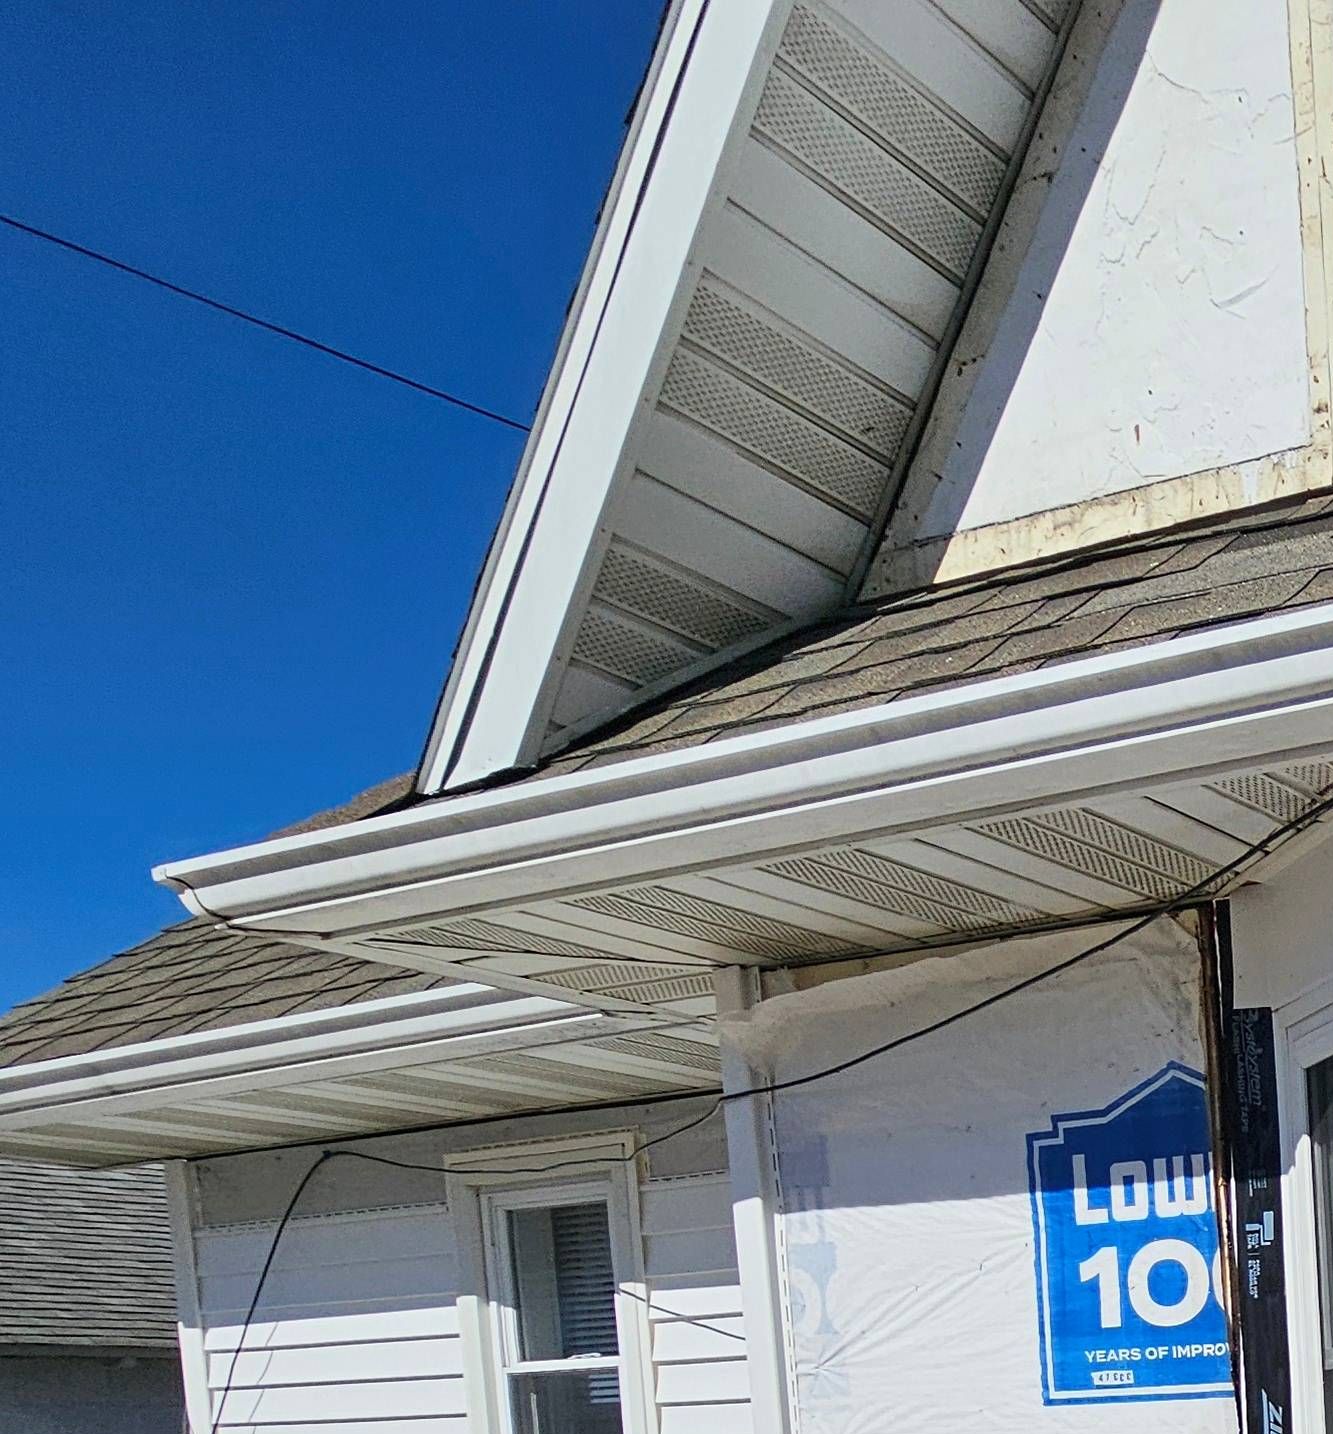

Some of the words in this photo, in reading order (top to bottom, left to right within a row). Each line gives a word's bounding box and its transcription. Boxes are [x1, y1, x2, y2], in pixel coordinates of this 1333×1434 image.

[1072, 1152, 1216, 1226] LOW
[1079, 1239, 1225, 1329] 10
[1085, 1349, 1142, 1363] YEARS
[1145, 1346, 1169, 1360] OF
